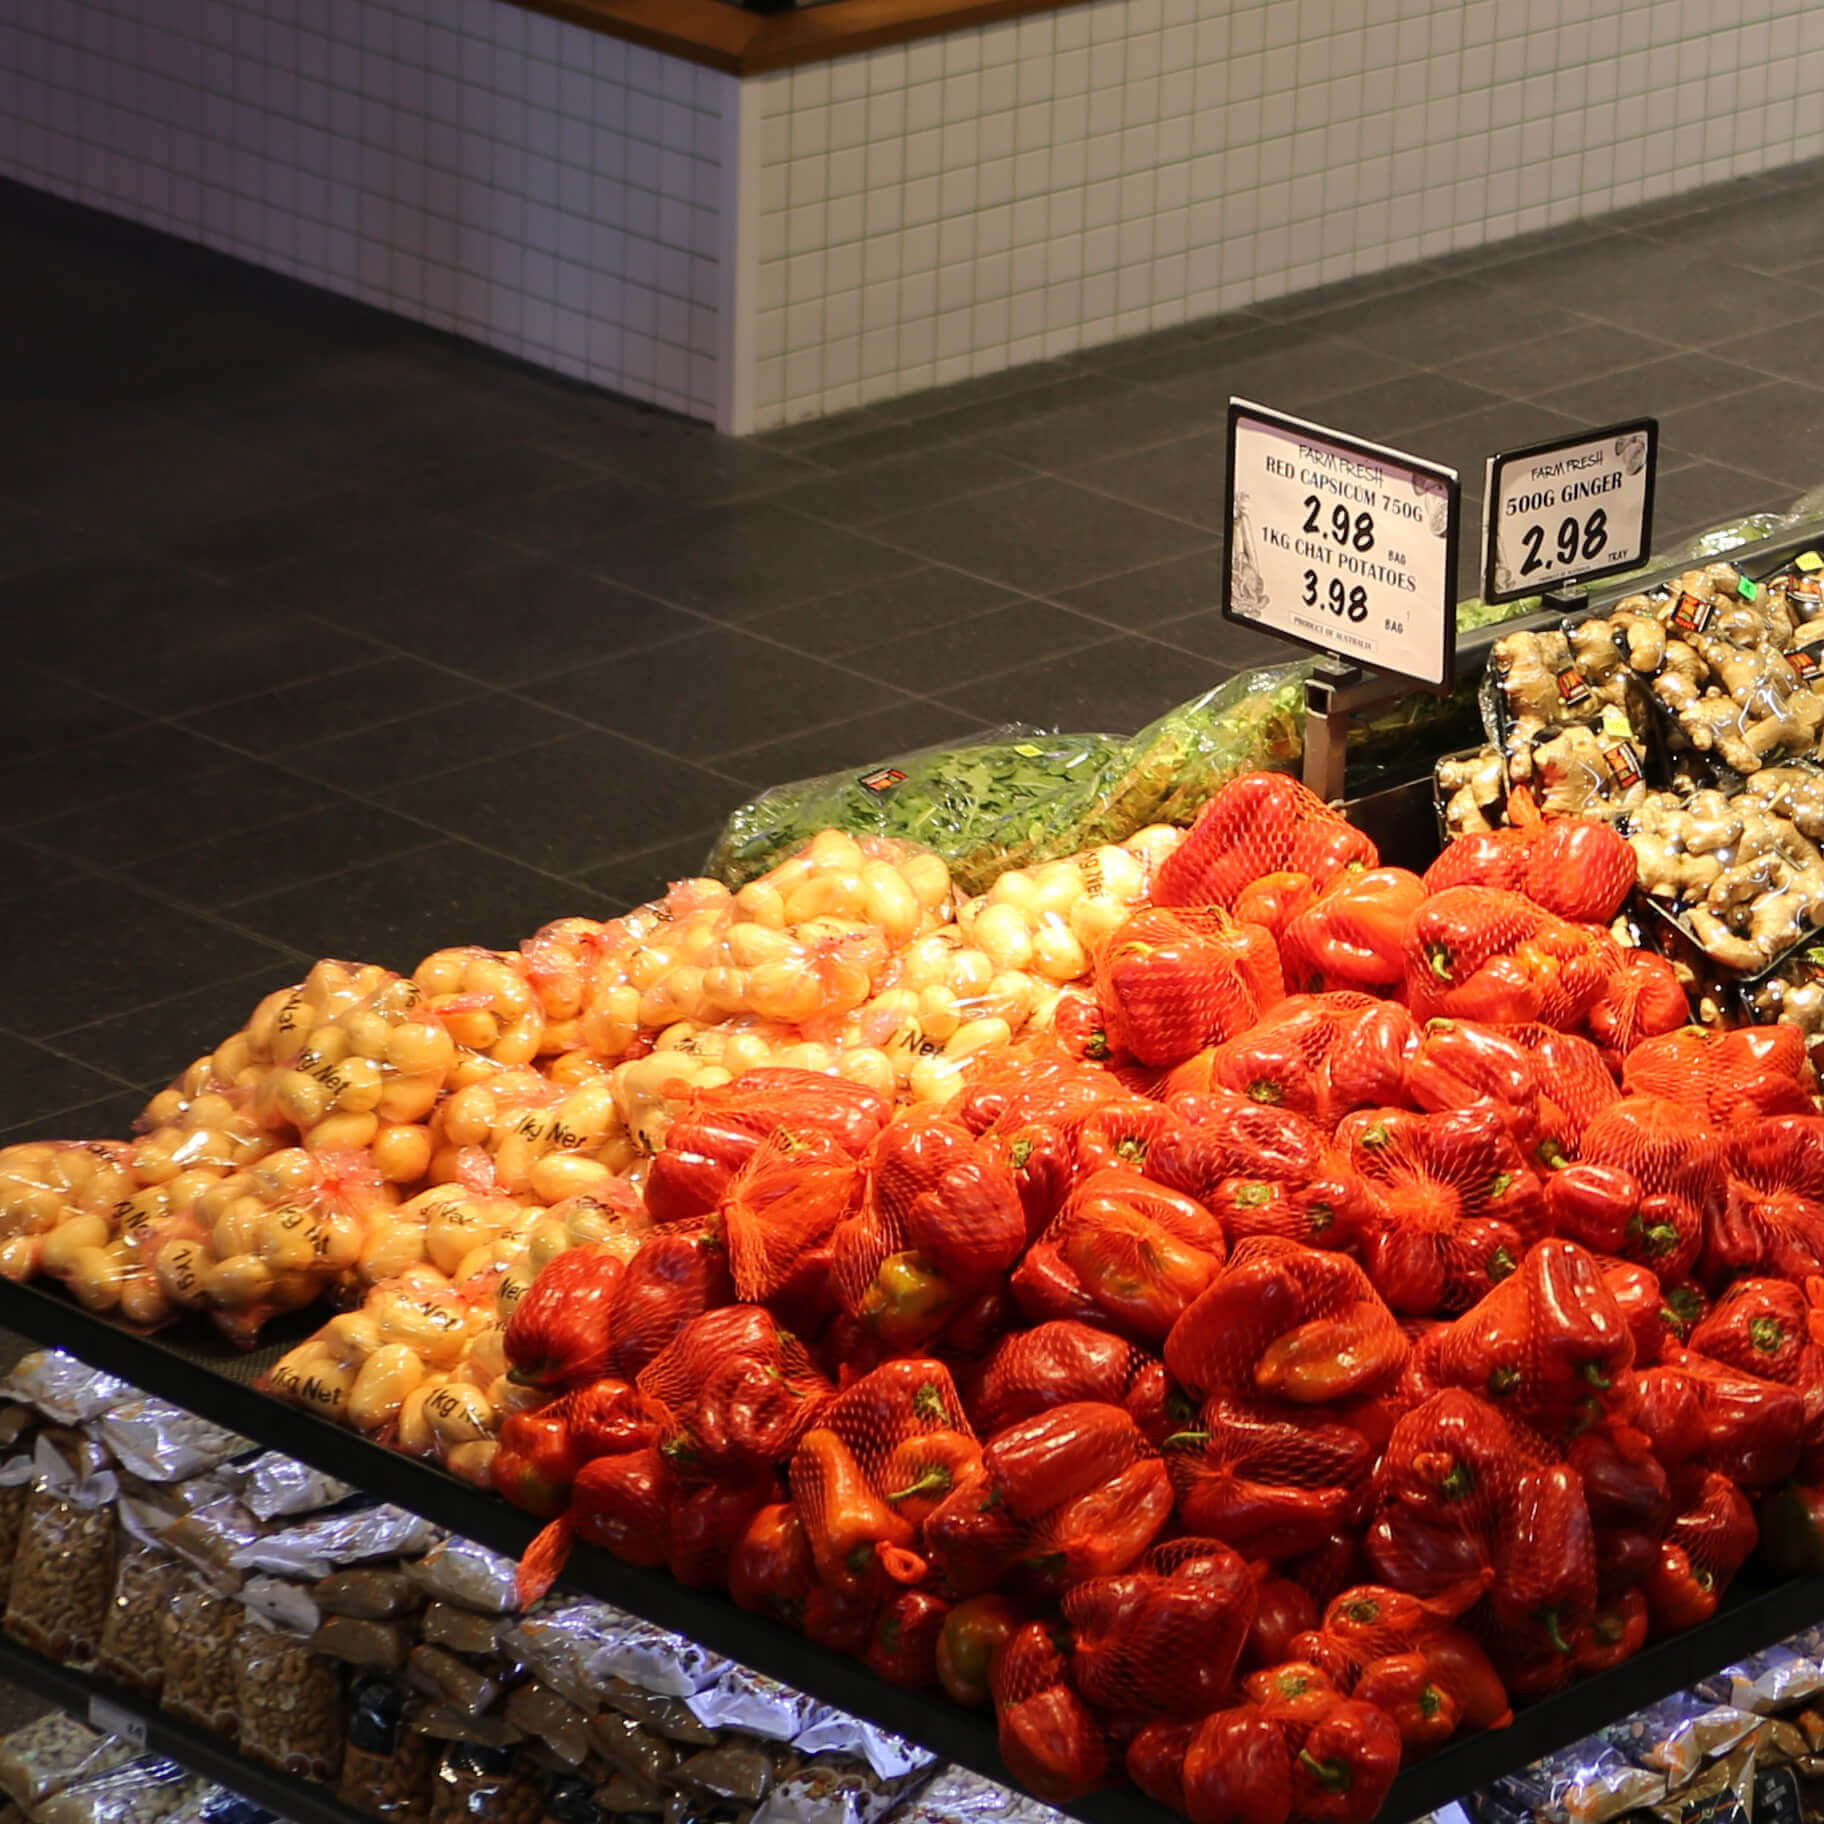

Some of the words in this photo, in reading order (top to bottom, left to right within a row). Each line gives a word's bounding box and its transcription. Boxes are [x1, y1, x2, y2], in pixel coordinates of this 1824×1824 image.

[1299, 444, 1338, 472] FARM
[1340, 457, 1385, 488] FRESH
[1531, 461, 1566, 482] FARM
[1566, 450, 1604, 473] FRESH
[1265, 455, 1295, 480] RED
[1301, 467, 1376, 507] CAPSICUM
[1382, 495, 1424, 523] 750G
[1505, 489, 1555, 517] 500G
[1561, 471, 1623, 504] GINGER
[1303, 495, 1376, 553] 2.98
[1520, 508, 1608, 577] 2.98
[1262, 526, 1291, 550] 1KG
[1295, 538, 1333, 565] CHAT
[1338, 552, 1417, 593] POTATOES
[1387, 549, 1407, 565] BAG
[1608, 549, 1629, 563] TRAY
[1302, 568, 1369, 623] 3.98
[1294, 615, 1323, 635] PRODUCT
[1325, 625, 1335, 638] OF
[1336, 631, 1373, 651] AUSTRALIA
[1384, 618, 1404, 635] BAG
[546, 1121, 588, 1152] Net
[271, 1365, 300, 1389] 1kg
[300, 1375, 343, 1407] Net
[423, 1386, 459, 1418] 1kg
